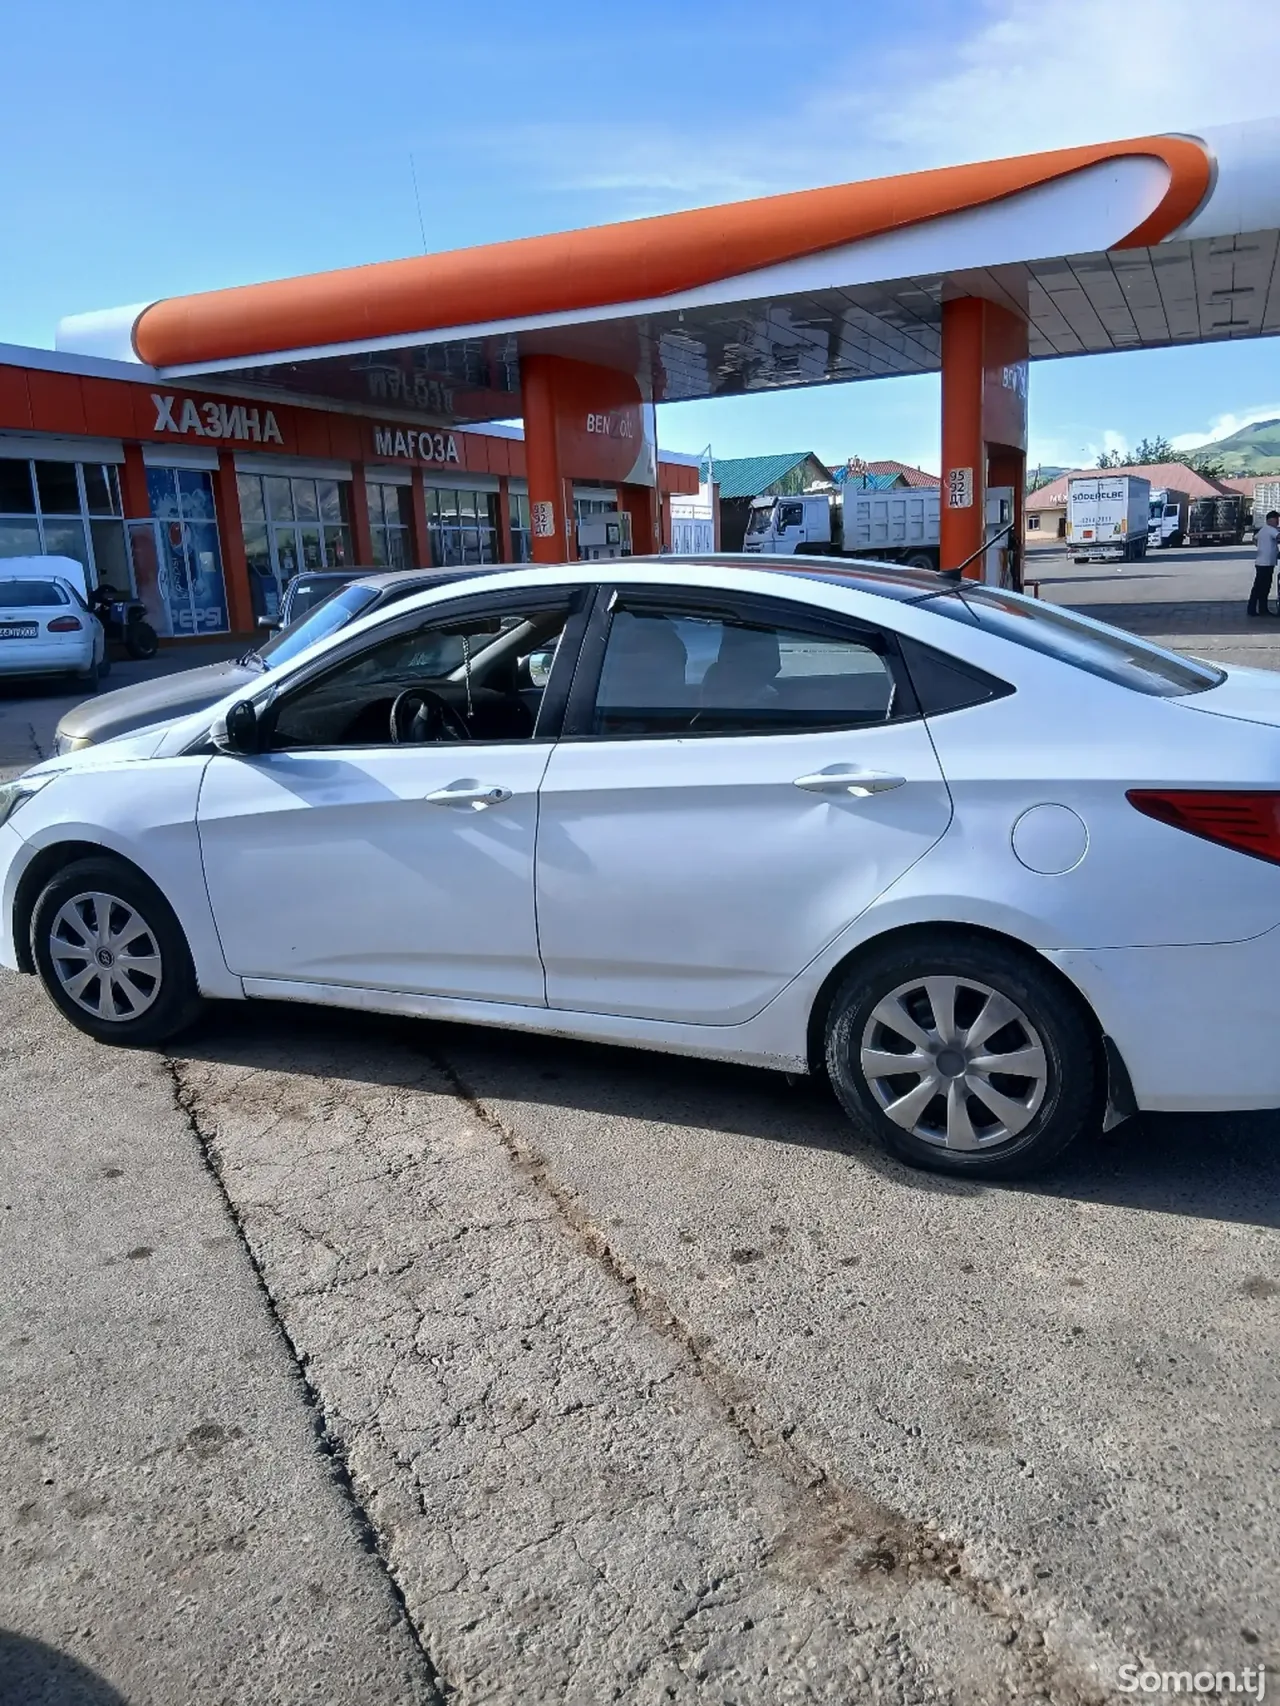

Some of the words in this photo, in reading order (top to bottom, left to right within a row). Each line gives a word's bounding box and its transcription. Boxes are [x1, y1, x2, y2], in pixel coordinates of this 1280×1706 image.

[150, 393, 284, 445] ХАЗИНА
[950, 470, 965, 481] 95
[950, 482, 965, 492] 92
[950, 493, 965, 506] ДТ
[535, 513, 547, 524] 92
